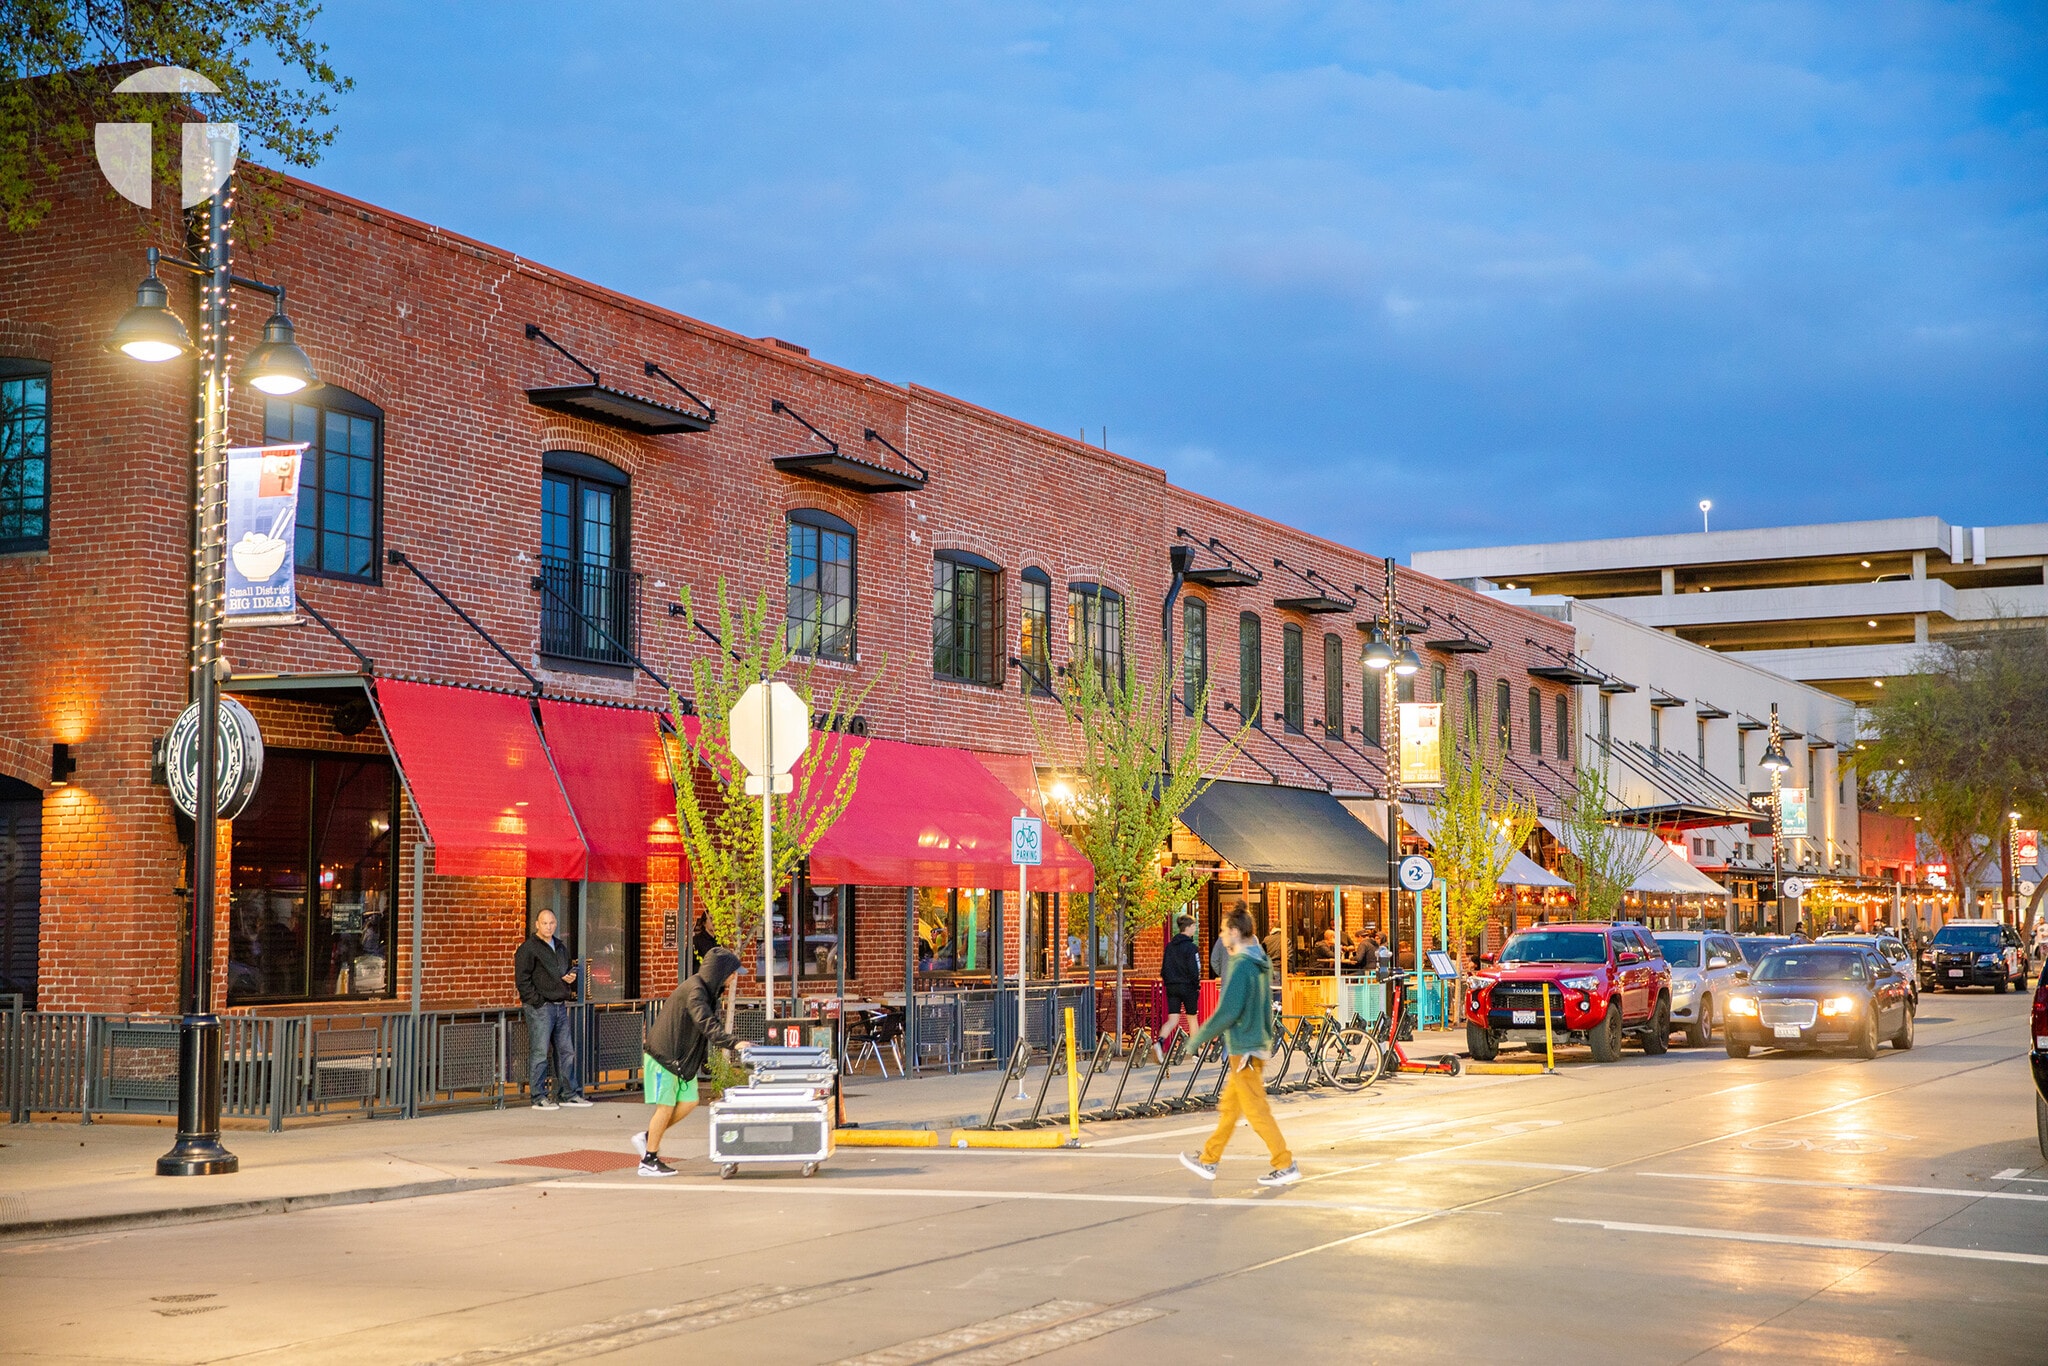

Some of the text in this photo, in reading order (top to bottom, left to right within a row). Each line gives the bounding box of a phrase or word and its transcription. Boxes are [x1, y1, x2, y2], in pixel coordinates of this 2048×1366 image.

[229, 584, 290, 598] Small District
[229, 595, 292, 610] BIG IDEAS
[1016, 849, 1038, 861] PARKING
